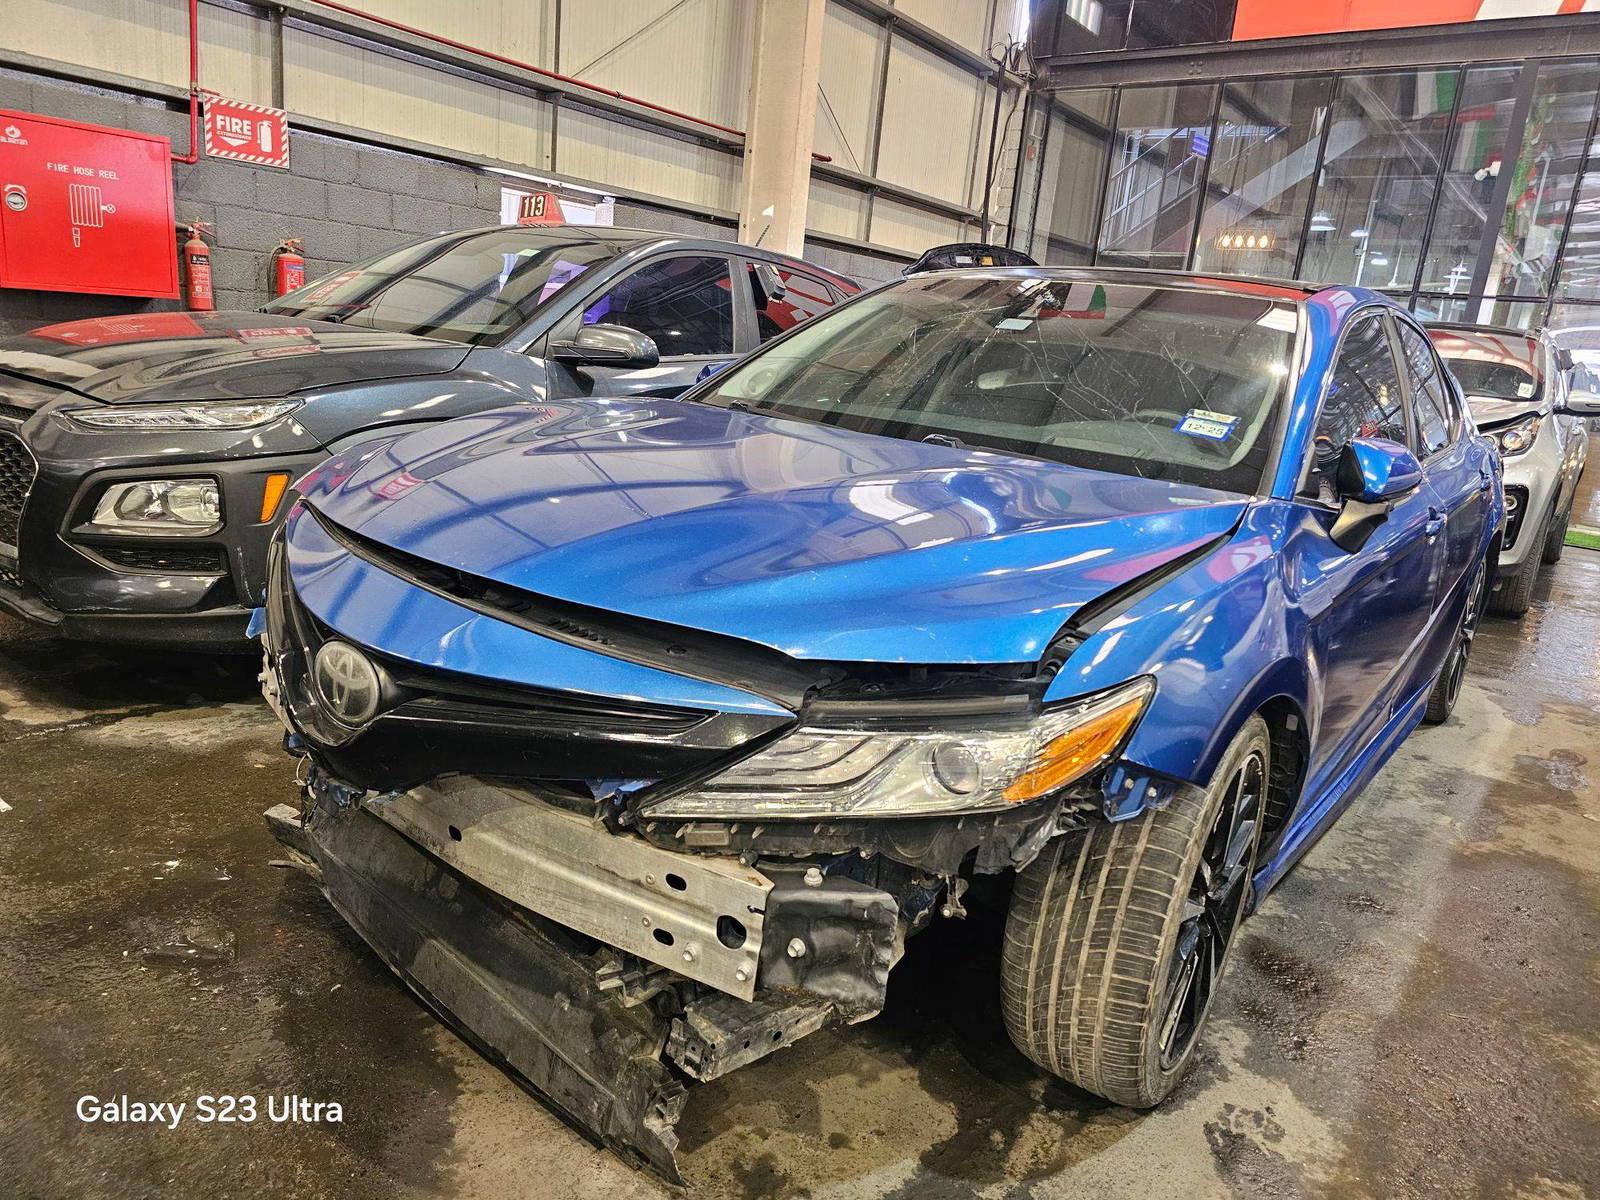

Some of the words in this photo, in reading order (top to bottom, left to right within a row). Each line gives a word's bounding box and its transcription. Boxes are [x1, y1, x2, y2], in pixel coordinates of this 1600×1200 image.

[216, 114, 252, 135] FIRE
[46, 162, 69, 173] FIRE
[73, 166, 95, 177] HOSE
[98, 170, 120, 180] REEL
[523, 195, 544, 218] 113
